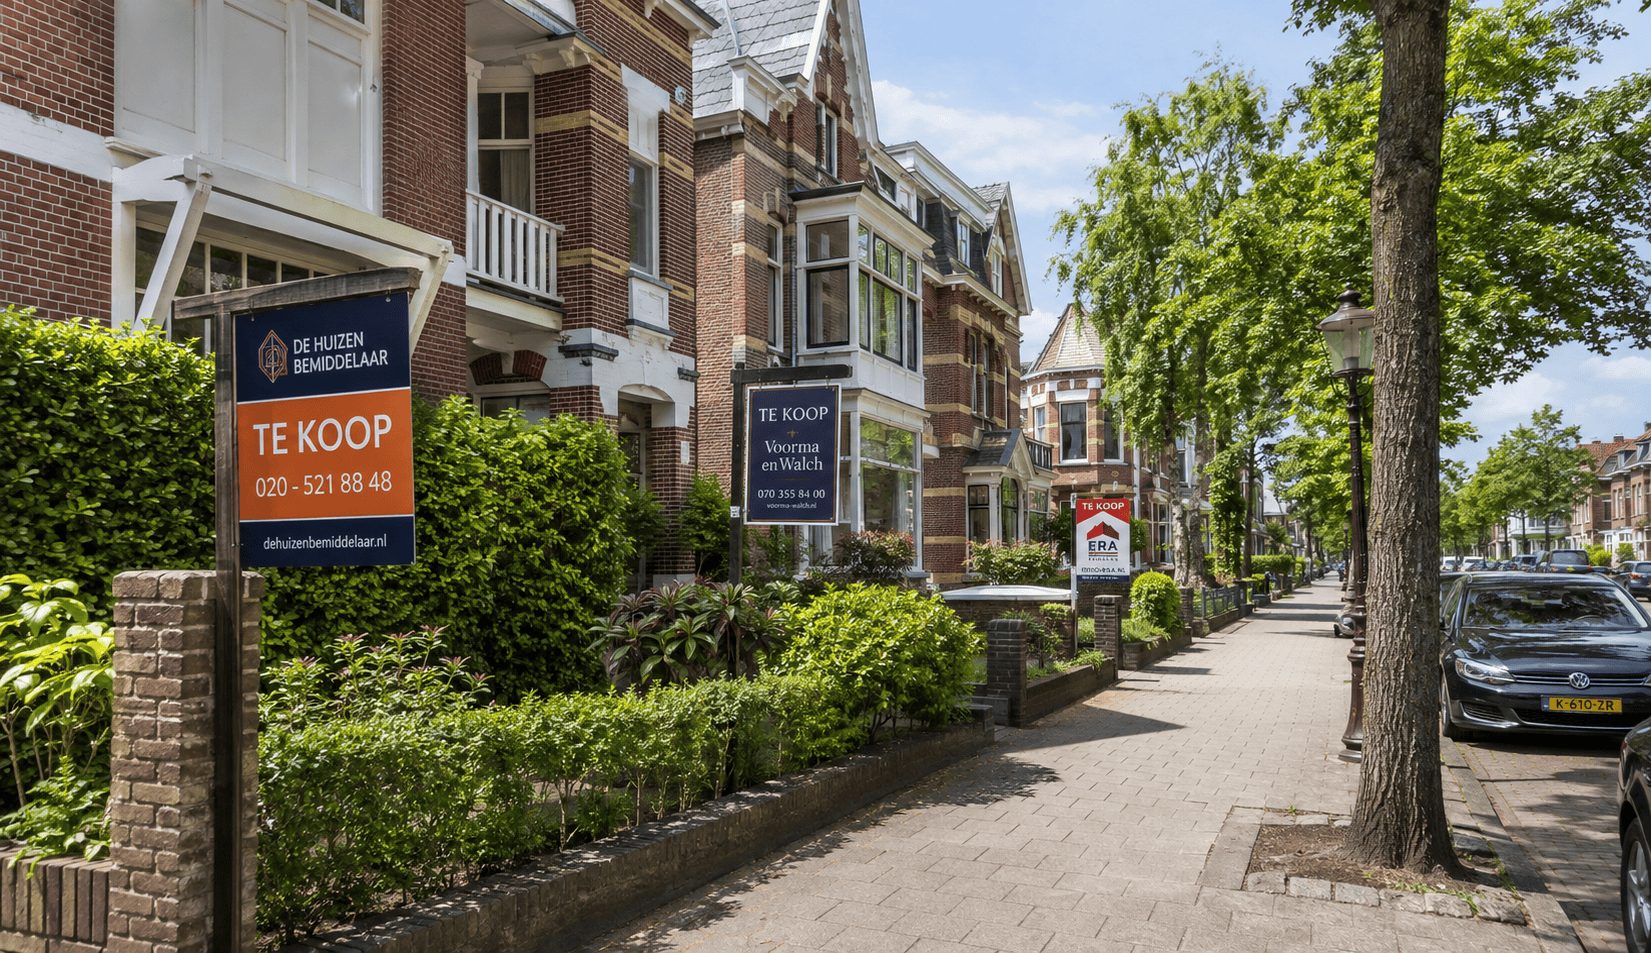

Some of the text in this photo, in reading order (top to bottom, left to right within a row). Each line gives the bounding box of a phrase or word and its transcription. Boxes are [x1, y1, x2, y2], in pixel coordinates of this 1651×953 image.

[293, 331, 364, 355] DE HUIZEN
[294, 349, 388, 374] BEMIDDELAAR
[758, 406, 829, 422] TE KOOP
[252, 414, 392, 456] TE KOOP
[764, 440, 820, 454] Voorma
[761, 456, 823, 471] en Walch
[255, 476, 288, 498] 020
[303, 474, 333, 495] 521
[340, 472, 363, 493] 88
[368, 470, 392, 492] 48
[757, 489, 826, 499] 070 355 84 00
[1081, 502, 1125, 510] TE KOOP
[263, 533, 387, 551] dehuizenbemiddelaar.nl
[1088, 540, 1118, 551] ERA
[1556, 698, 1614, 711] K-610-ZR
